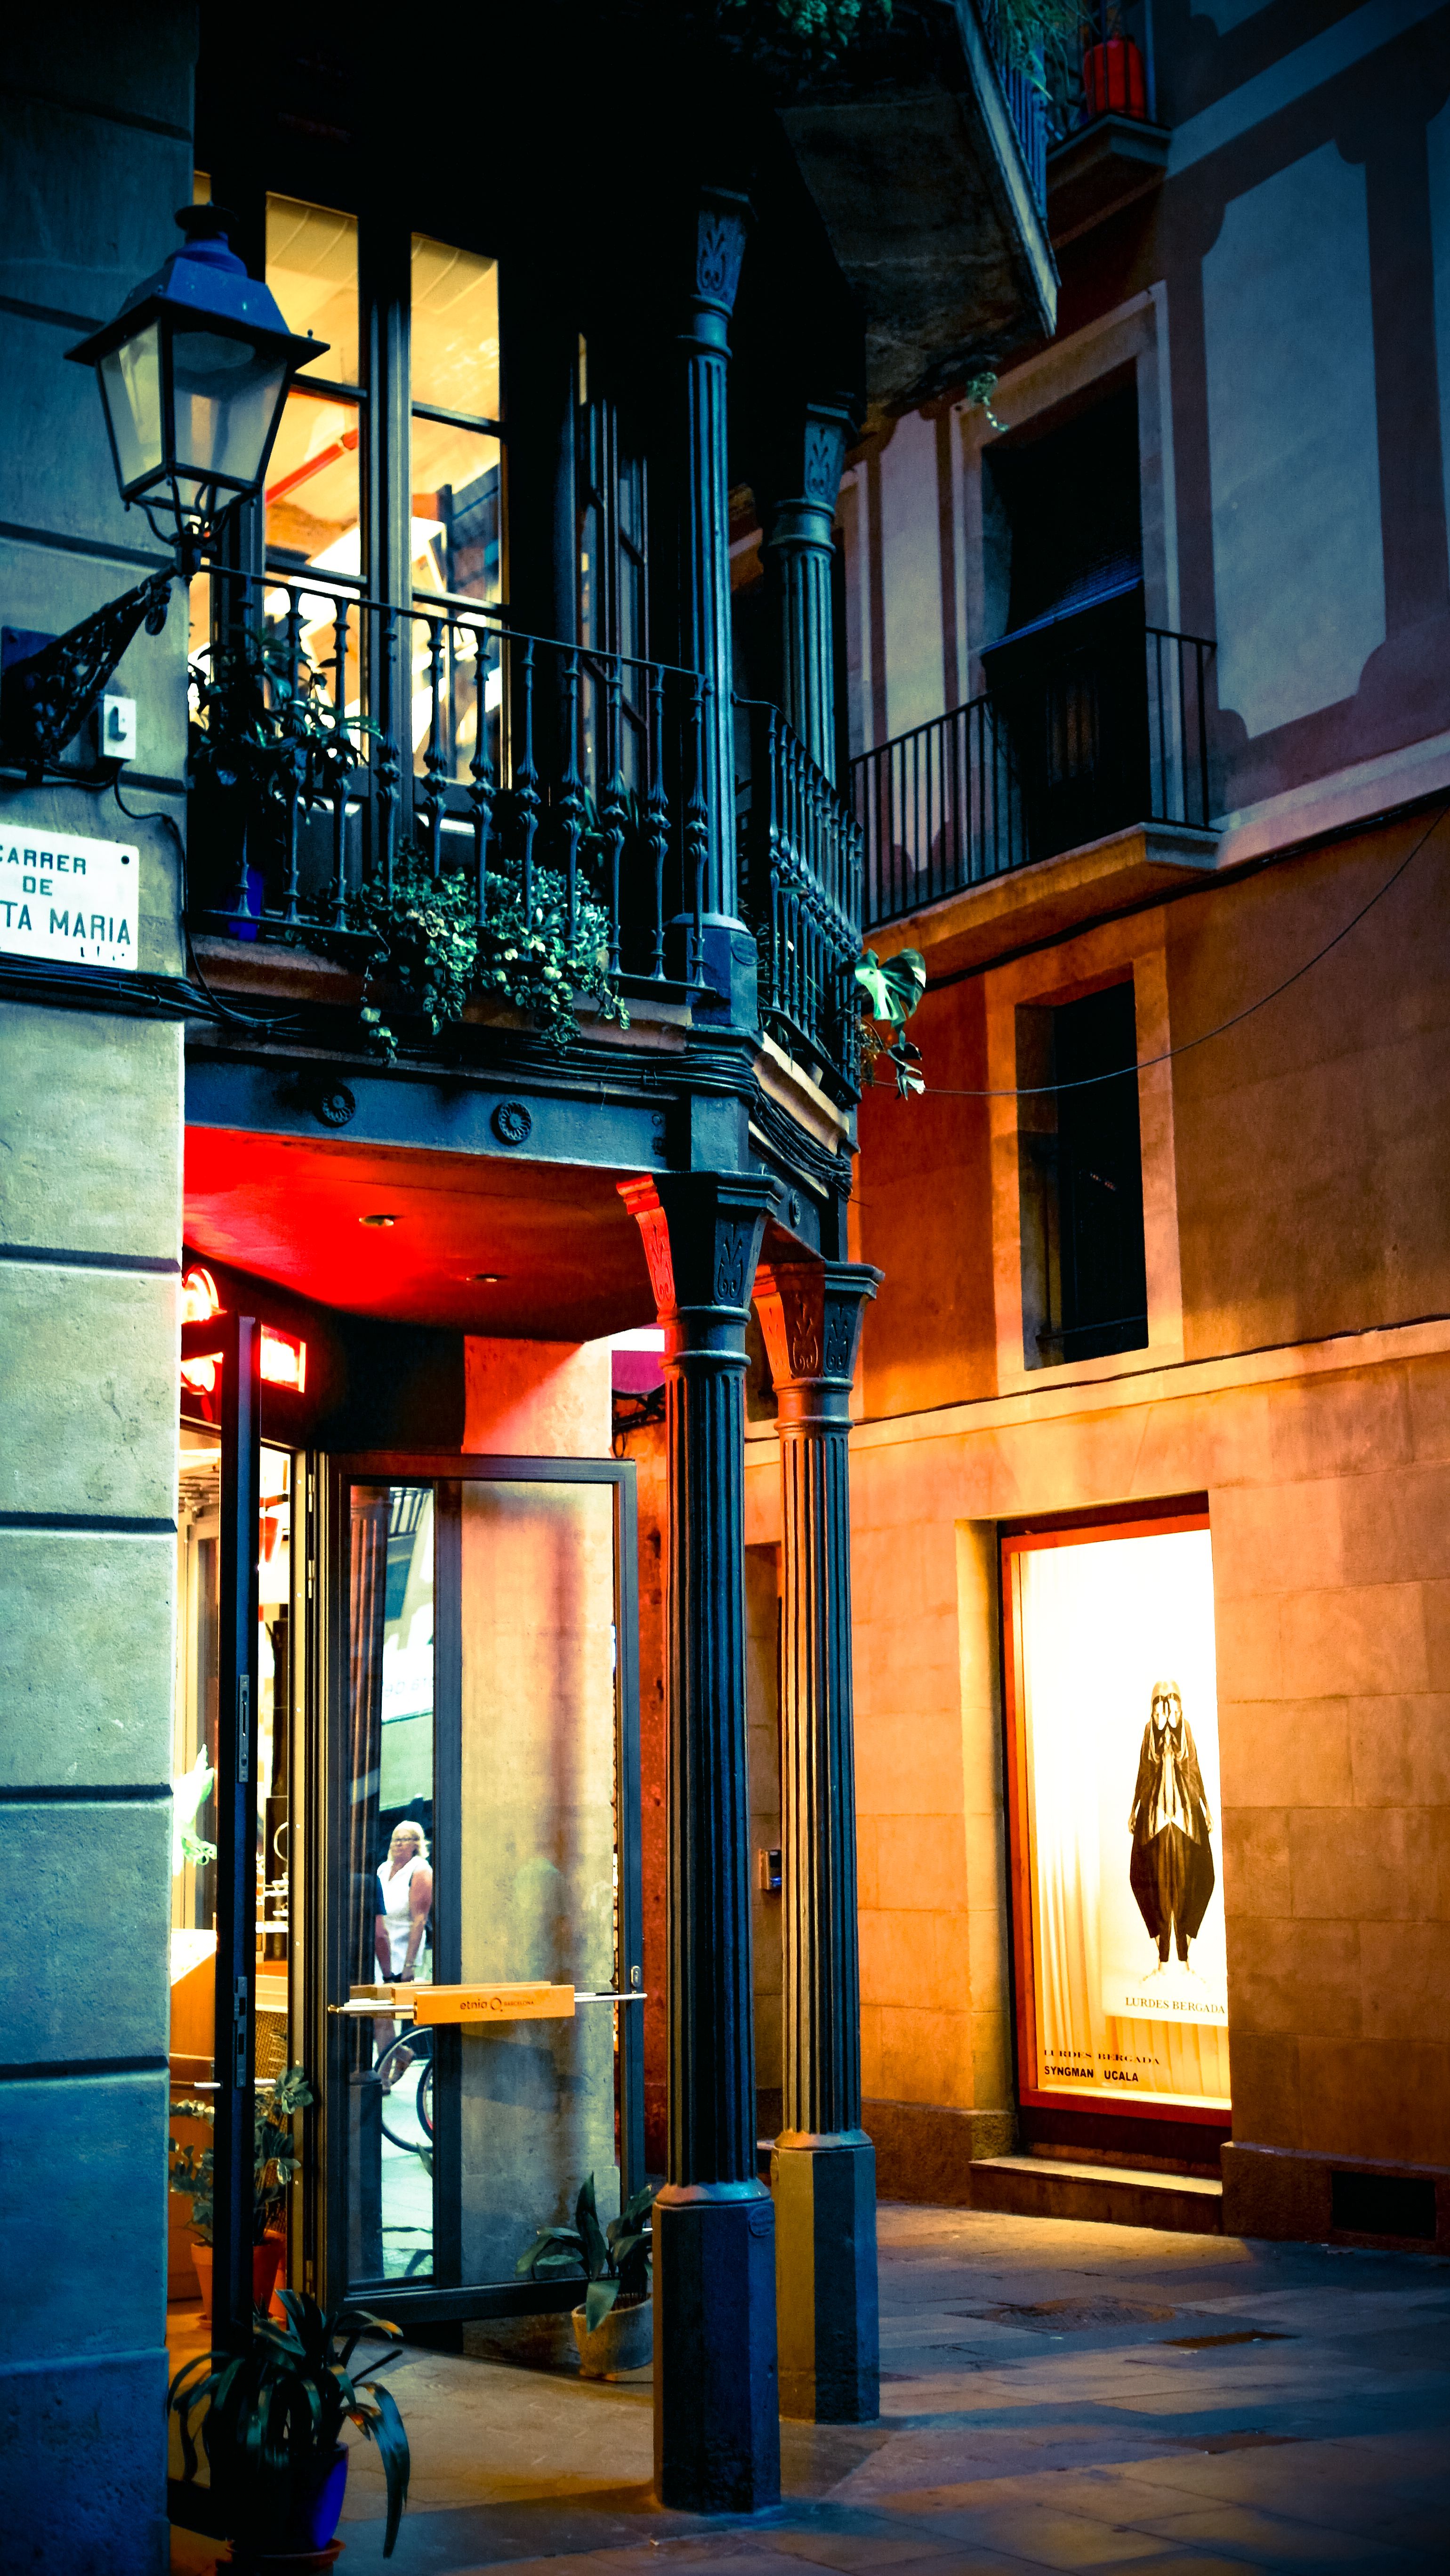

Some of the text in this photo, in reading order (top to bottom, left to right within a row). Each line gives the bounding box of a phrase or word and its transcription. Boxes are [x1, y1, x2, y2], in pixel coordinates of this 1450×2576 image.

[0, 845, 86, 875] ARRER
[23, 876, 53, 896] DE
[49, 908, 130, 945] MARIA
[460, 1999, 487, 2010] etnia
[1126, 1997, 1225, 2014] LURDES BERGADA
[1044, 2050, 1159, 2065] LURDES BERGADA
[1044, 2066, 1139, 2082] SYNGMAN UCALA
